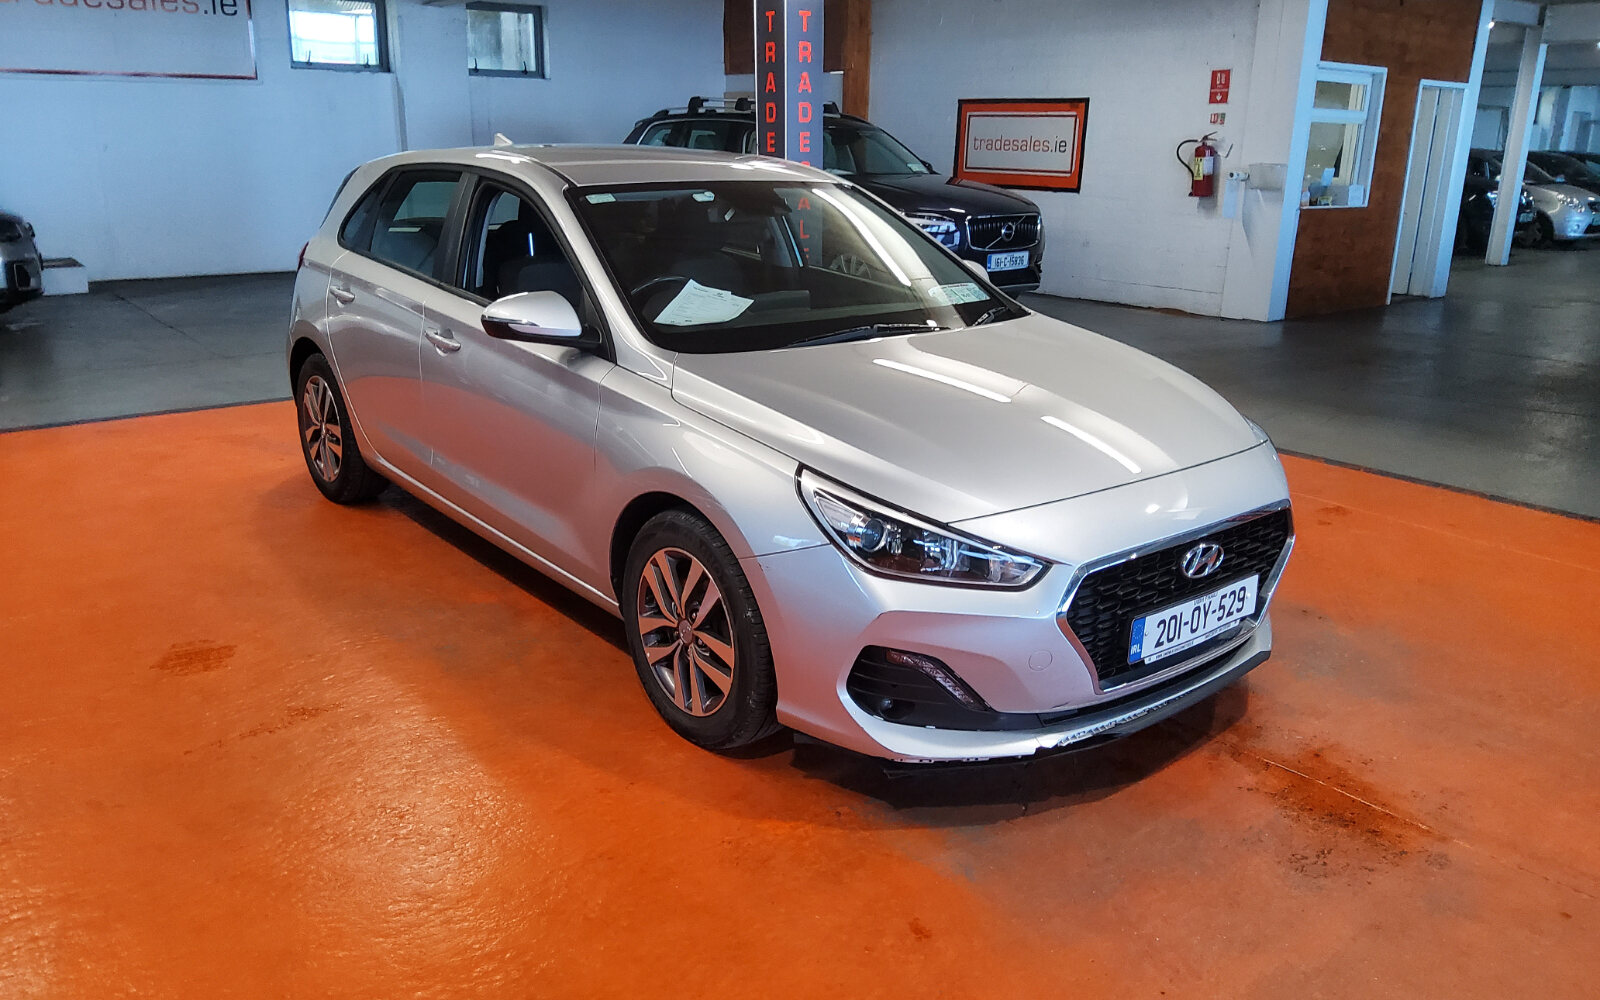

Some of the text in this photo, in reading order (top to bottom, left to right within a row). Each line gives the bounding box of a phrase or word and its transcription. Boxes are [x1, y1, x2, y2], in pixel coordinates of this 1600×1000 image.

[0, 0, 238, 16] saes.ie
[766, 10, 777, 153] TRADE
[973, 134, 1067, 153] tradesales.ie
[1154, 585, 1247, 649] 201-OY-529
[1130, 643, 1141, 655] IRL
